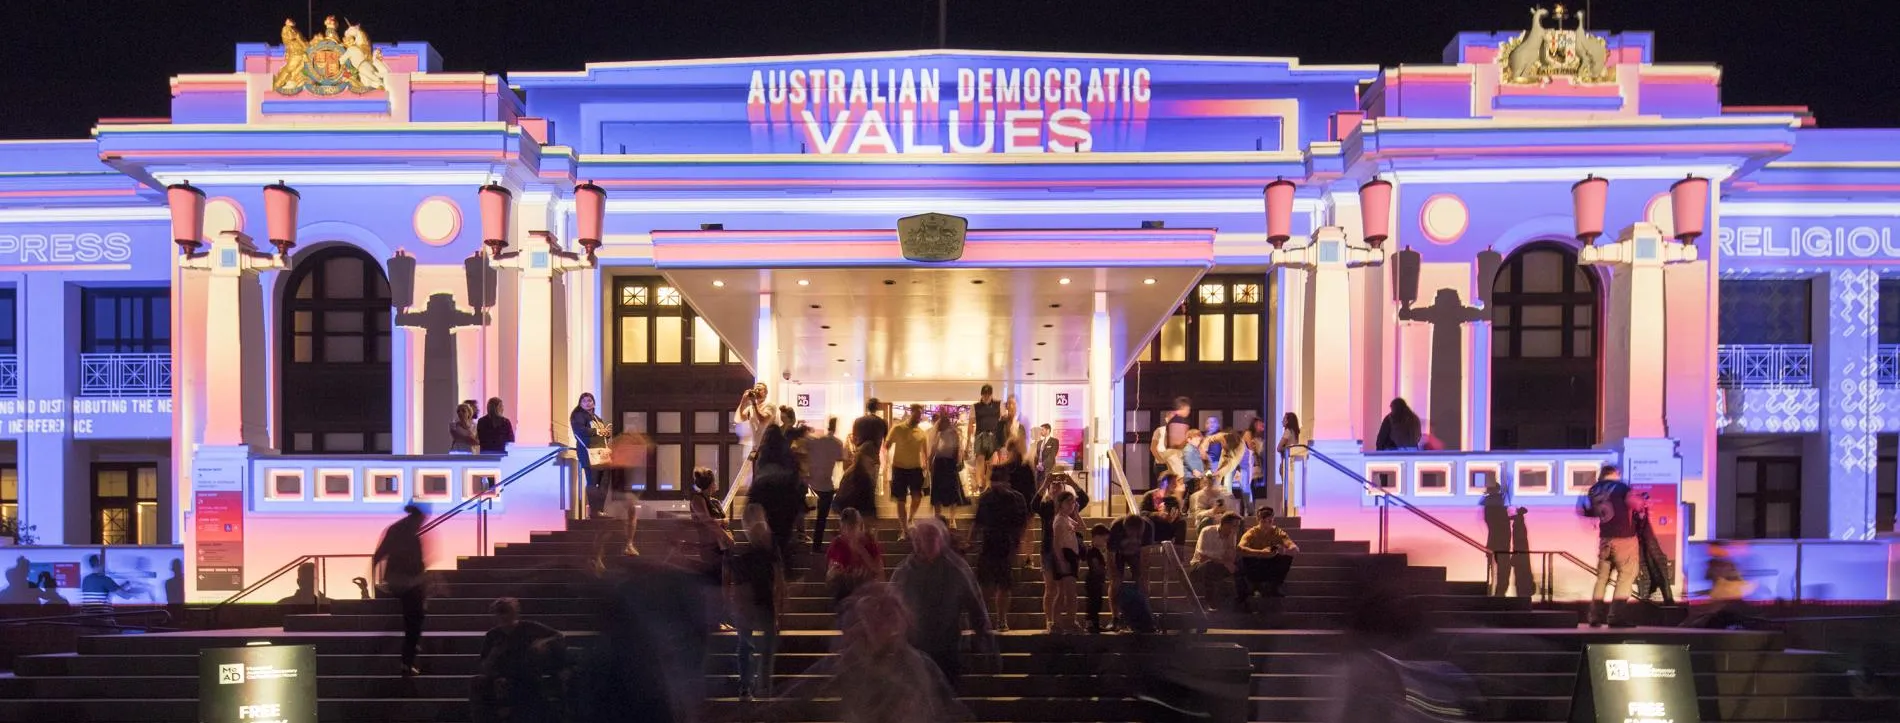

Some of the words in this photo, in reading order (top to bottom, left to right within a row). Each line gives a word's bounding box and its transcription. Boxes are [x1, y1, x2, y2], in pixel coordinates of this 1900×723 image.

[747, 68, 940, 104] AUSTRALIAN
[957, 67, 1152, 103] DEMOCRATIC
[801, 108, 1093, 154] VALUES
[0, 232, 131, 263] PRESS
[132, 399, 154, 413] THE
[223, 672, 241, 681] AD
